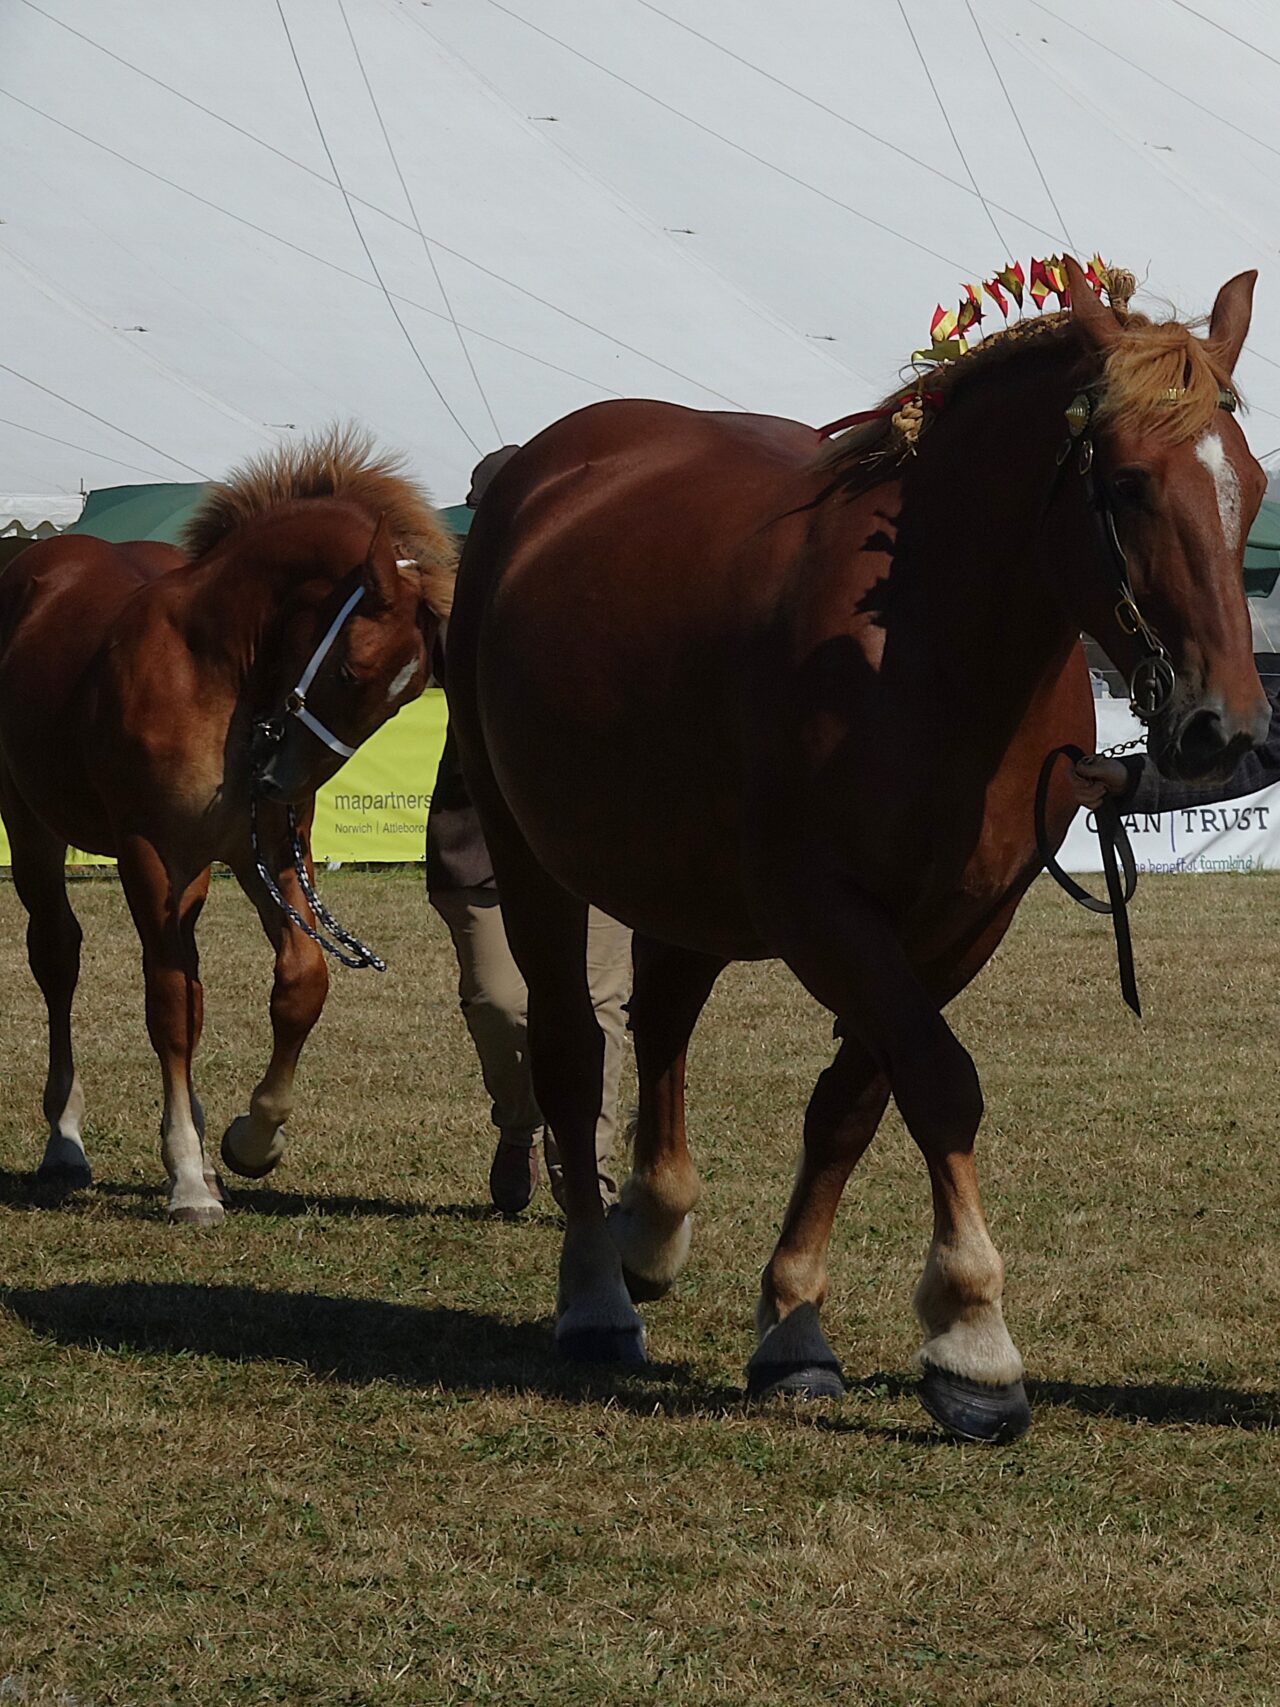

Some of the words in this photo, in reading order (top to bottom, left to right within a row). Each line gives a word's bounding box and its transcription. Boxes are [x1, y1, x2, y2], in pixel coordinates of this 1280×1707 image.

[335, 792, 432, 814] mapartners
[335, 824, 372, 834] Norwich
[1085, 810, 1161, 834] CAN
[1181, 807, 1270, 834] TRUST
